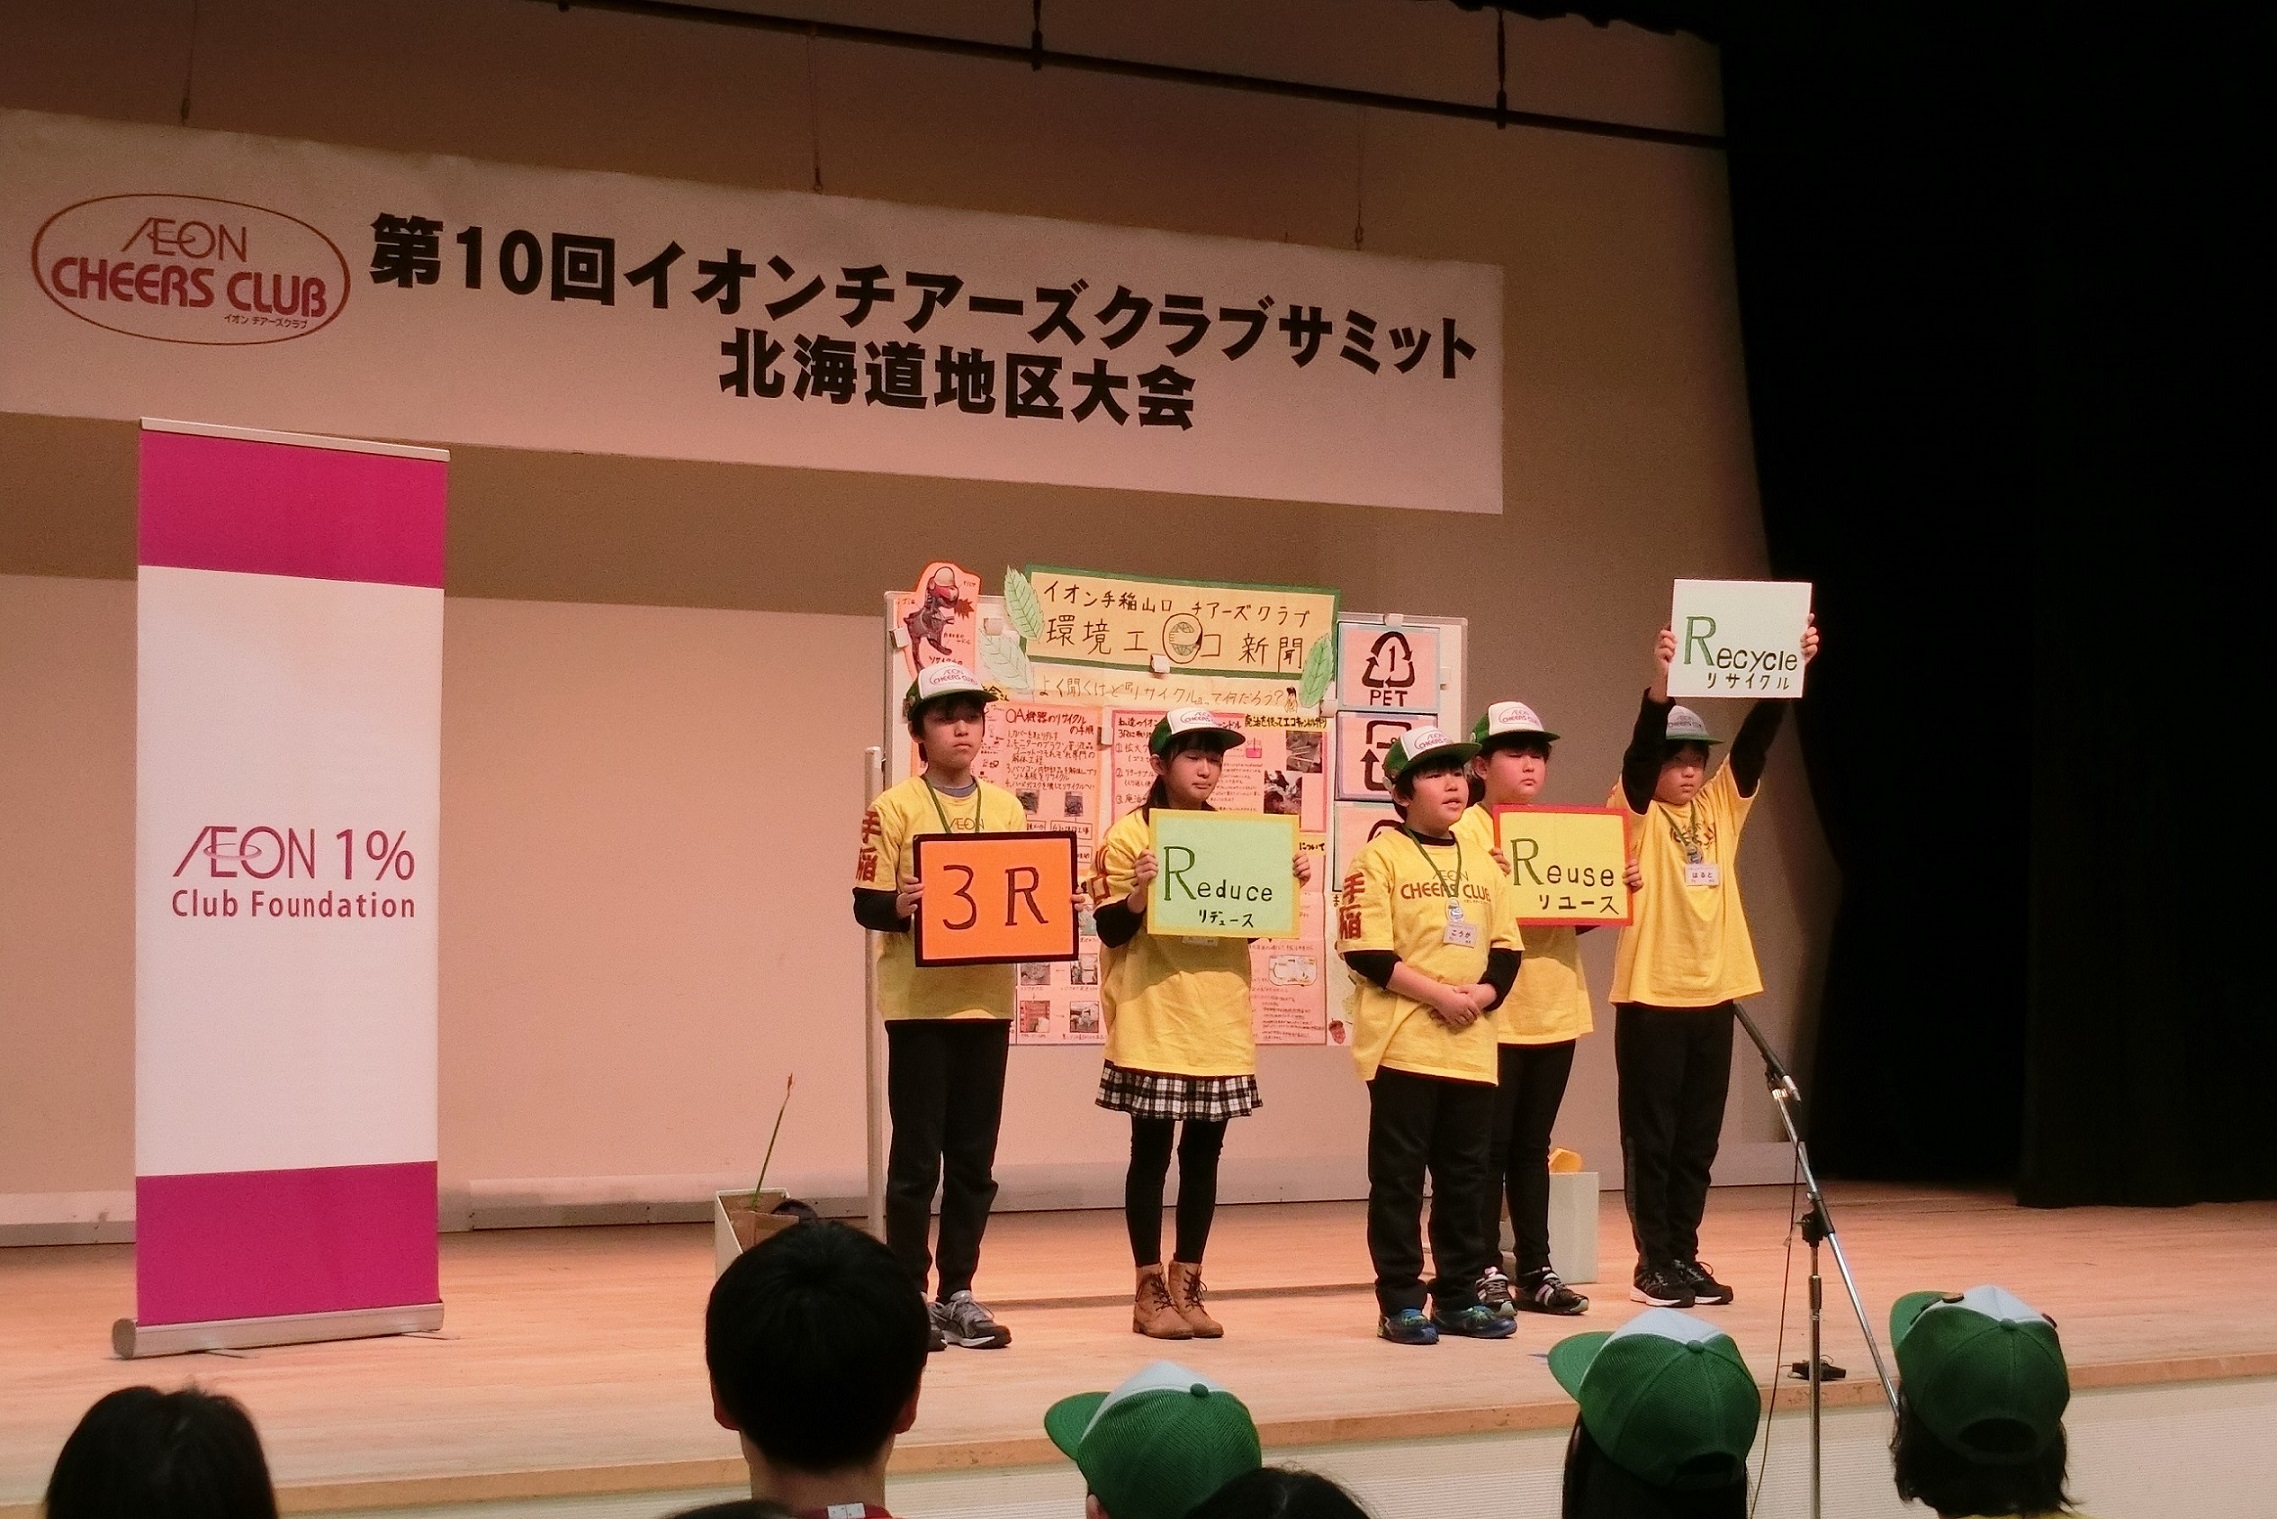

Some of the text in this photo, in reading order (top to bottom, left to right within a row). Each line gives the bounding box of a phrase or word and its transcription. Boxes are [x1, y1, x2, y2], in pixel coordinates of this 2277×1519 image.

[51, 256, 327, 318] CHEERS CLUB
[369, 212, 1477, 379] 第10回イオンチアーズクラブサミット
[719, 327, 1197, 431] 北海道地区大会
[1684, 615, 1798, 672] Recycle
[1369, 689, 1408, 707] PET
[1707, 672, 1790, 691] リサイクル
[336, 828, 415, 881] 1%
[1164, 846, 1273, 901] Reduce
[1510, 838, 1614, 887] Reuse
[172, 889, 415, 918] Club Foundation
[1199, 909, 1254, 928] リデュース
[1539, 894, 1619, 915] リユース
